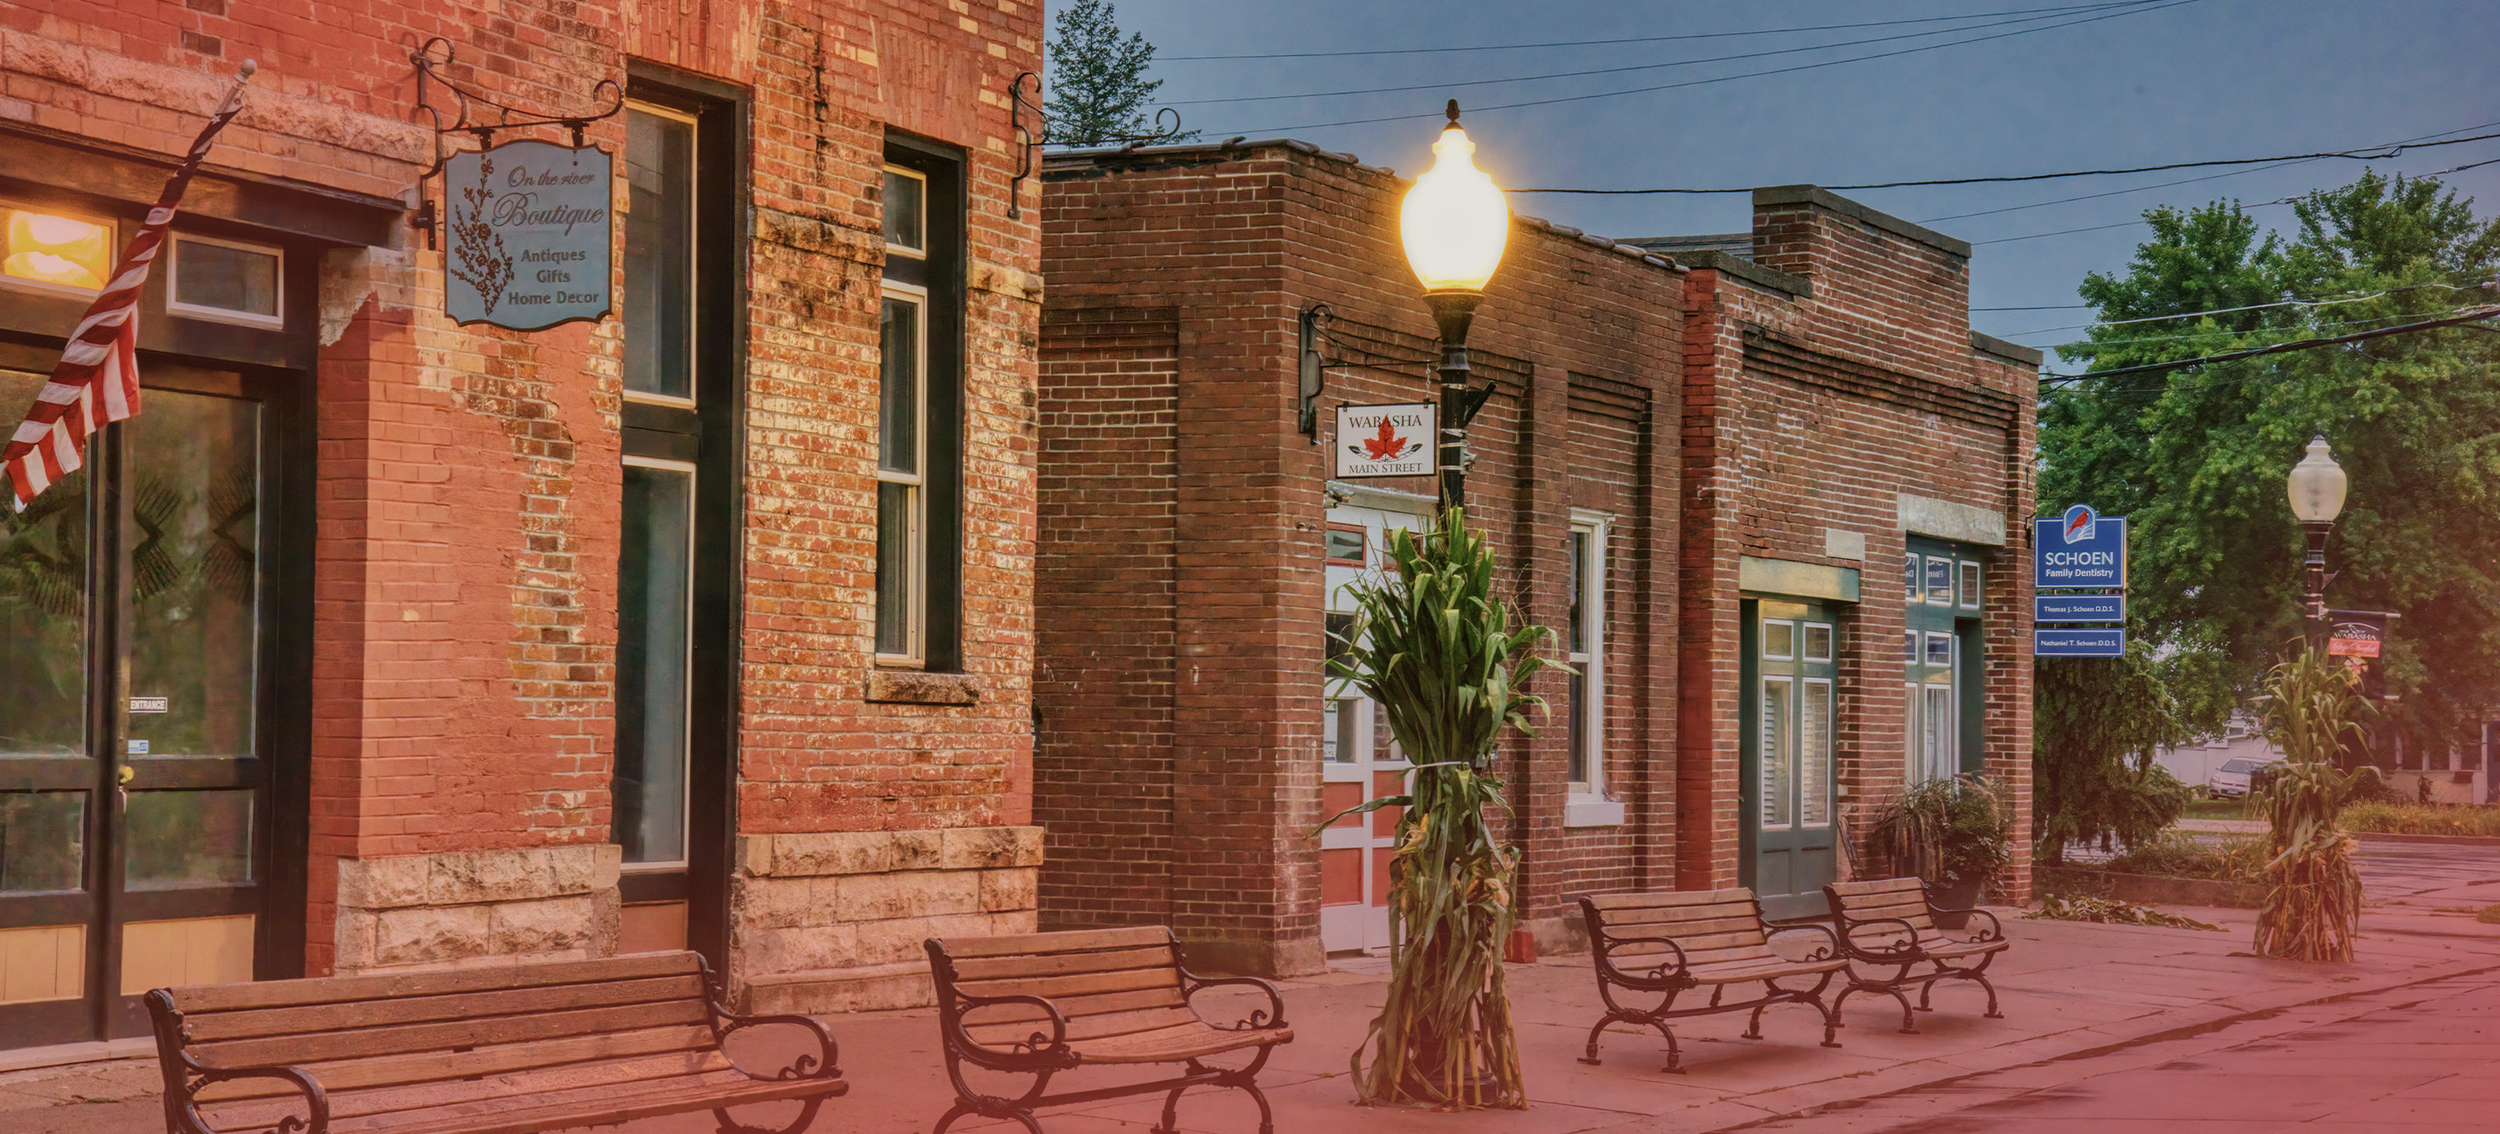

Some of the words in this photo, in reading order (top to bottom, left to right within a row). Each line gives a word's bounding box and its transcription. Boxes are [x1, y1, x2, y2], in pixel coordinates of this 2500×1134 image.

[508, 165, 534, 187] On
[537, 168, 558, 185] the
[561, 171, 595, 185] river
[491, 192, 604, 236] Boutique
[521, 248, 586, 265] Antiques
[536, 269, 571, 283] Gifts
[508, 292, 551, 305] Home
[556, 290, 599, 304] Decor
[1348, 464, 1379, 474] MAIN
[1382, 462, 1423, 473] STREET
[2045, 551, 2114, 566] SCHOEN
[2045, 568, 2073, 579] Family
[2075, 568, 2114, 579] Dentistry
[2334, 632, 2376, 640] WABASHA
[130, 700, 166, 710] ENTRANCE
